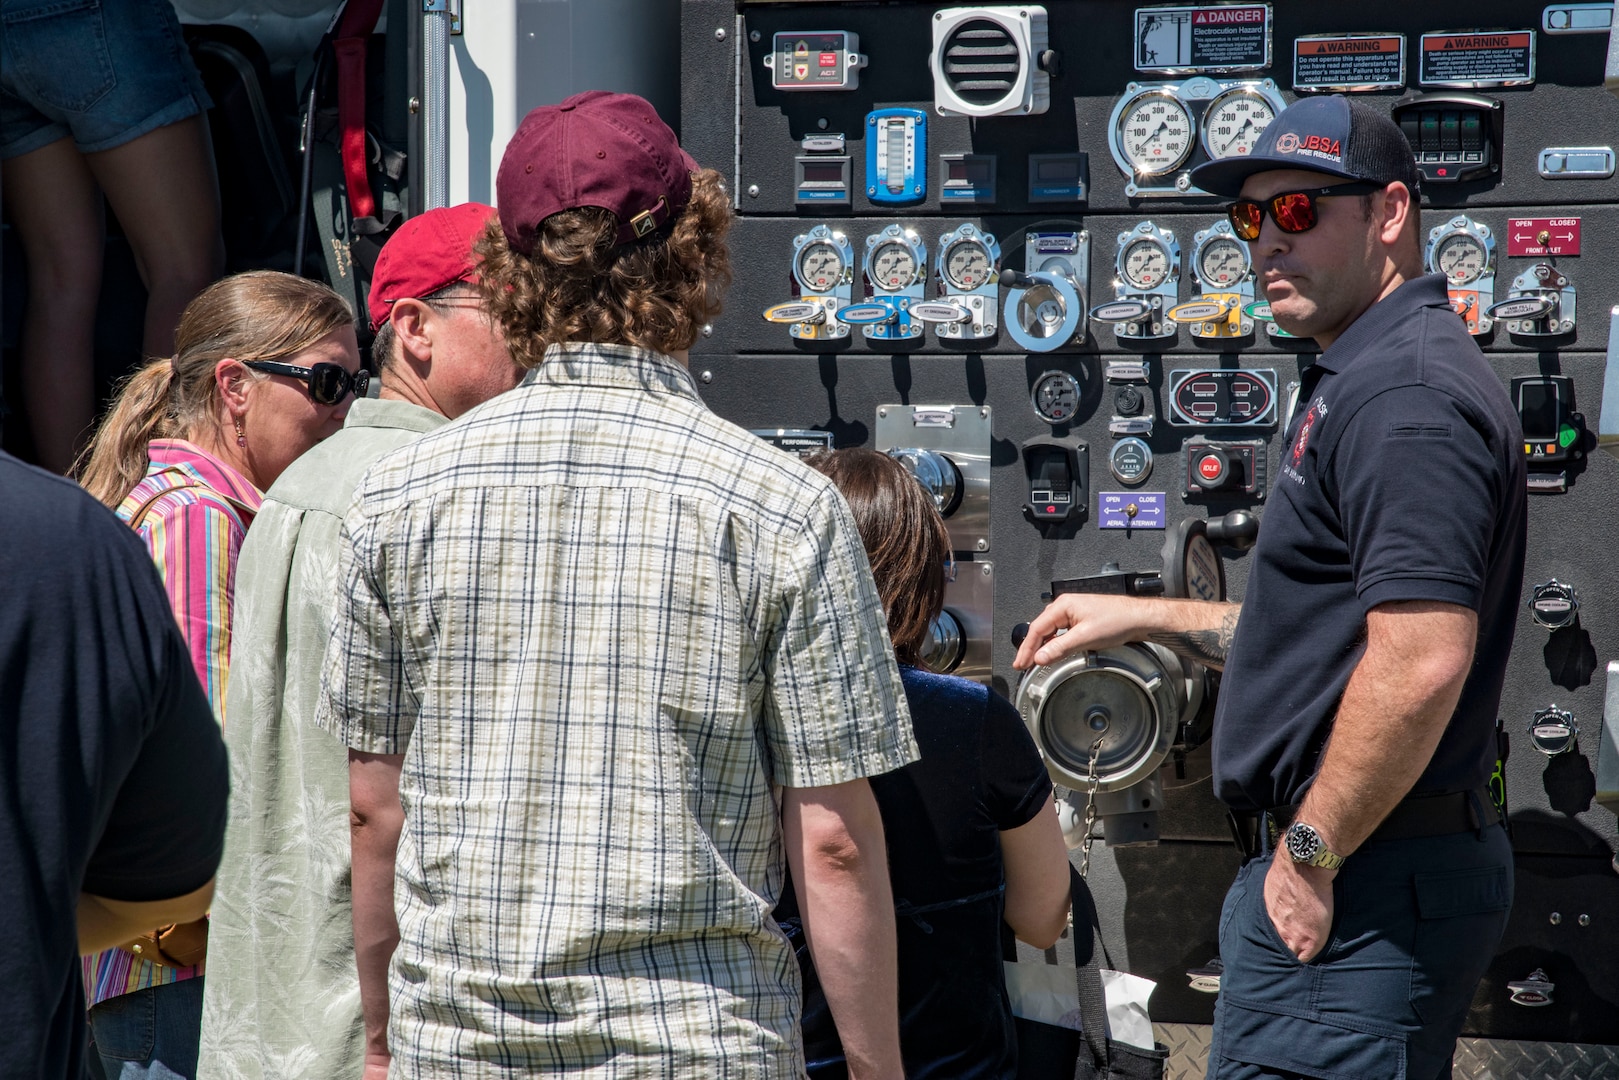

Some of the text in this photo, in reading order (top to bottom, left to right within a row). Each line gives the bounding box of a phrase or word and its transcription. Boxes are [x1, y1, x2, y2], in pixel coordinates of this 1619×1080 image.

[1208, 10, 1261, 22] DANGER
[1194, 27, 1237, 35] Electrocution
[1328, 42, 1380, 52] WARNING
[1454, 36, 1508, 48] WARNING
[1136, 114, 1150, 122] 200
[1222, 113, 1236, 122] 200
[1134, 128, 1146, 136] 100
[1218, 126, 1230, 135] 100
[1300, 135, 1341, 156] JBSA
[1313, 151, 1342, 162] RESCUE
[331, 238, 346, 278] Series
